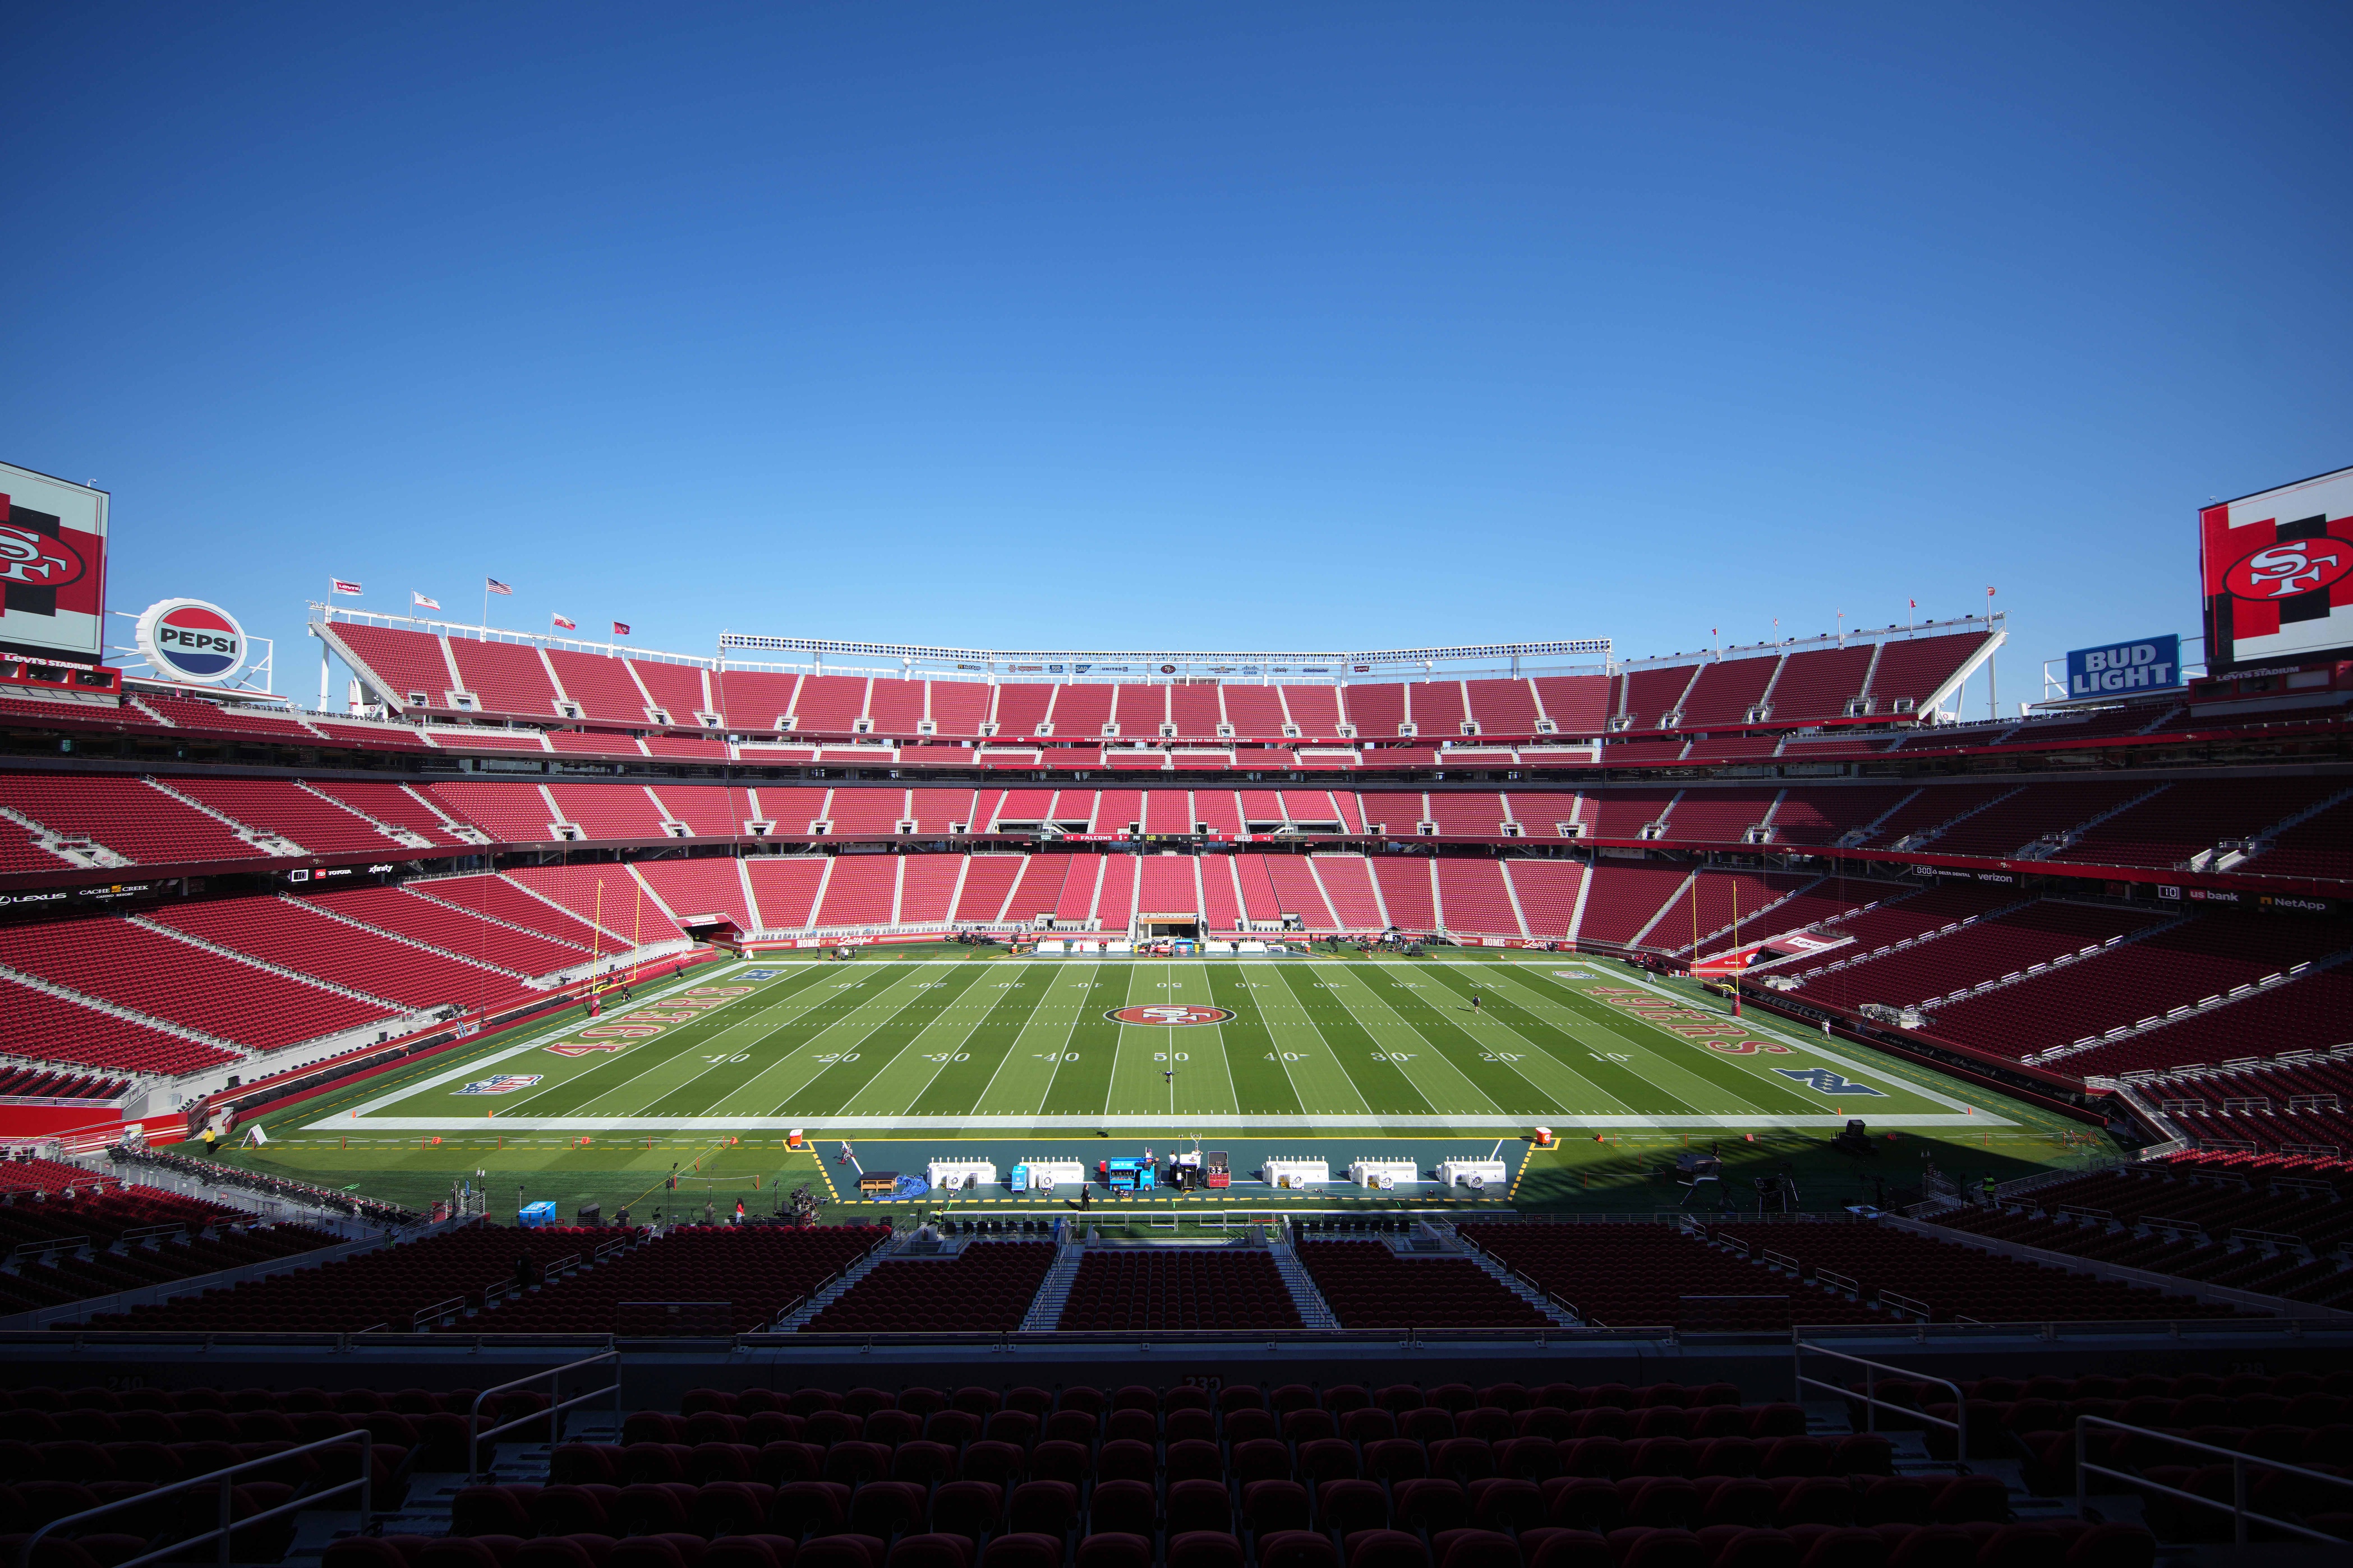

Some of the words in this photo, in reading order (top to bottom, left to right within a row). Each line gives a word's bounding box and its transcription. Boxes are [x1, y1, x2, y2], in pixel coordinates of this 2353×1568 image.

[161, 628, 236, 654] PEPSI
[2085, 644, 2156, 672] BUD
[48, 660, 93, 671] STADIUM
[2254, 666, 2299, 677] STADIUM
[2074, 662, 2172, 694] LIGHT
[368, 864, 393, 874] xfinity
[297, 871, 306, 880] 10
[1977, 873, 2013, 883] verizon
[2165, 888, 2176, 897] 10
[2190, 889, 2205, 898] us
[2207, 891, 2239, 902] bank
[13, 893, 67, 902] LEXUS
[2274, 897, 2326, 911] NetApp
[797, 939, 820, 948] HOME
[837, 936, 874, 946] Faithful
[1482, 938, 1505, 947] HOME
[541, 986, 757, 1058] 49ERS
[1580, 986, 1799, 1055] 49ERS
[706, 1053, 750, 1062] 10
[818, 1053, 860, 1062] 20
[931, 1053, 970, 1062] 30
[1043, 1053, 1080, 1062] 40
[1154, 1053, 1189, 1062] 50
[1263, 1053, 1298, 1062] 40
[1370, 1053, 1411, 1062] 30
[1478, 1053, 1518, 1062] 20
[1587, 1053, 1628, 1062] 10
